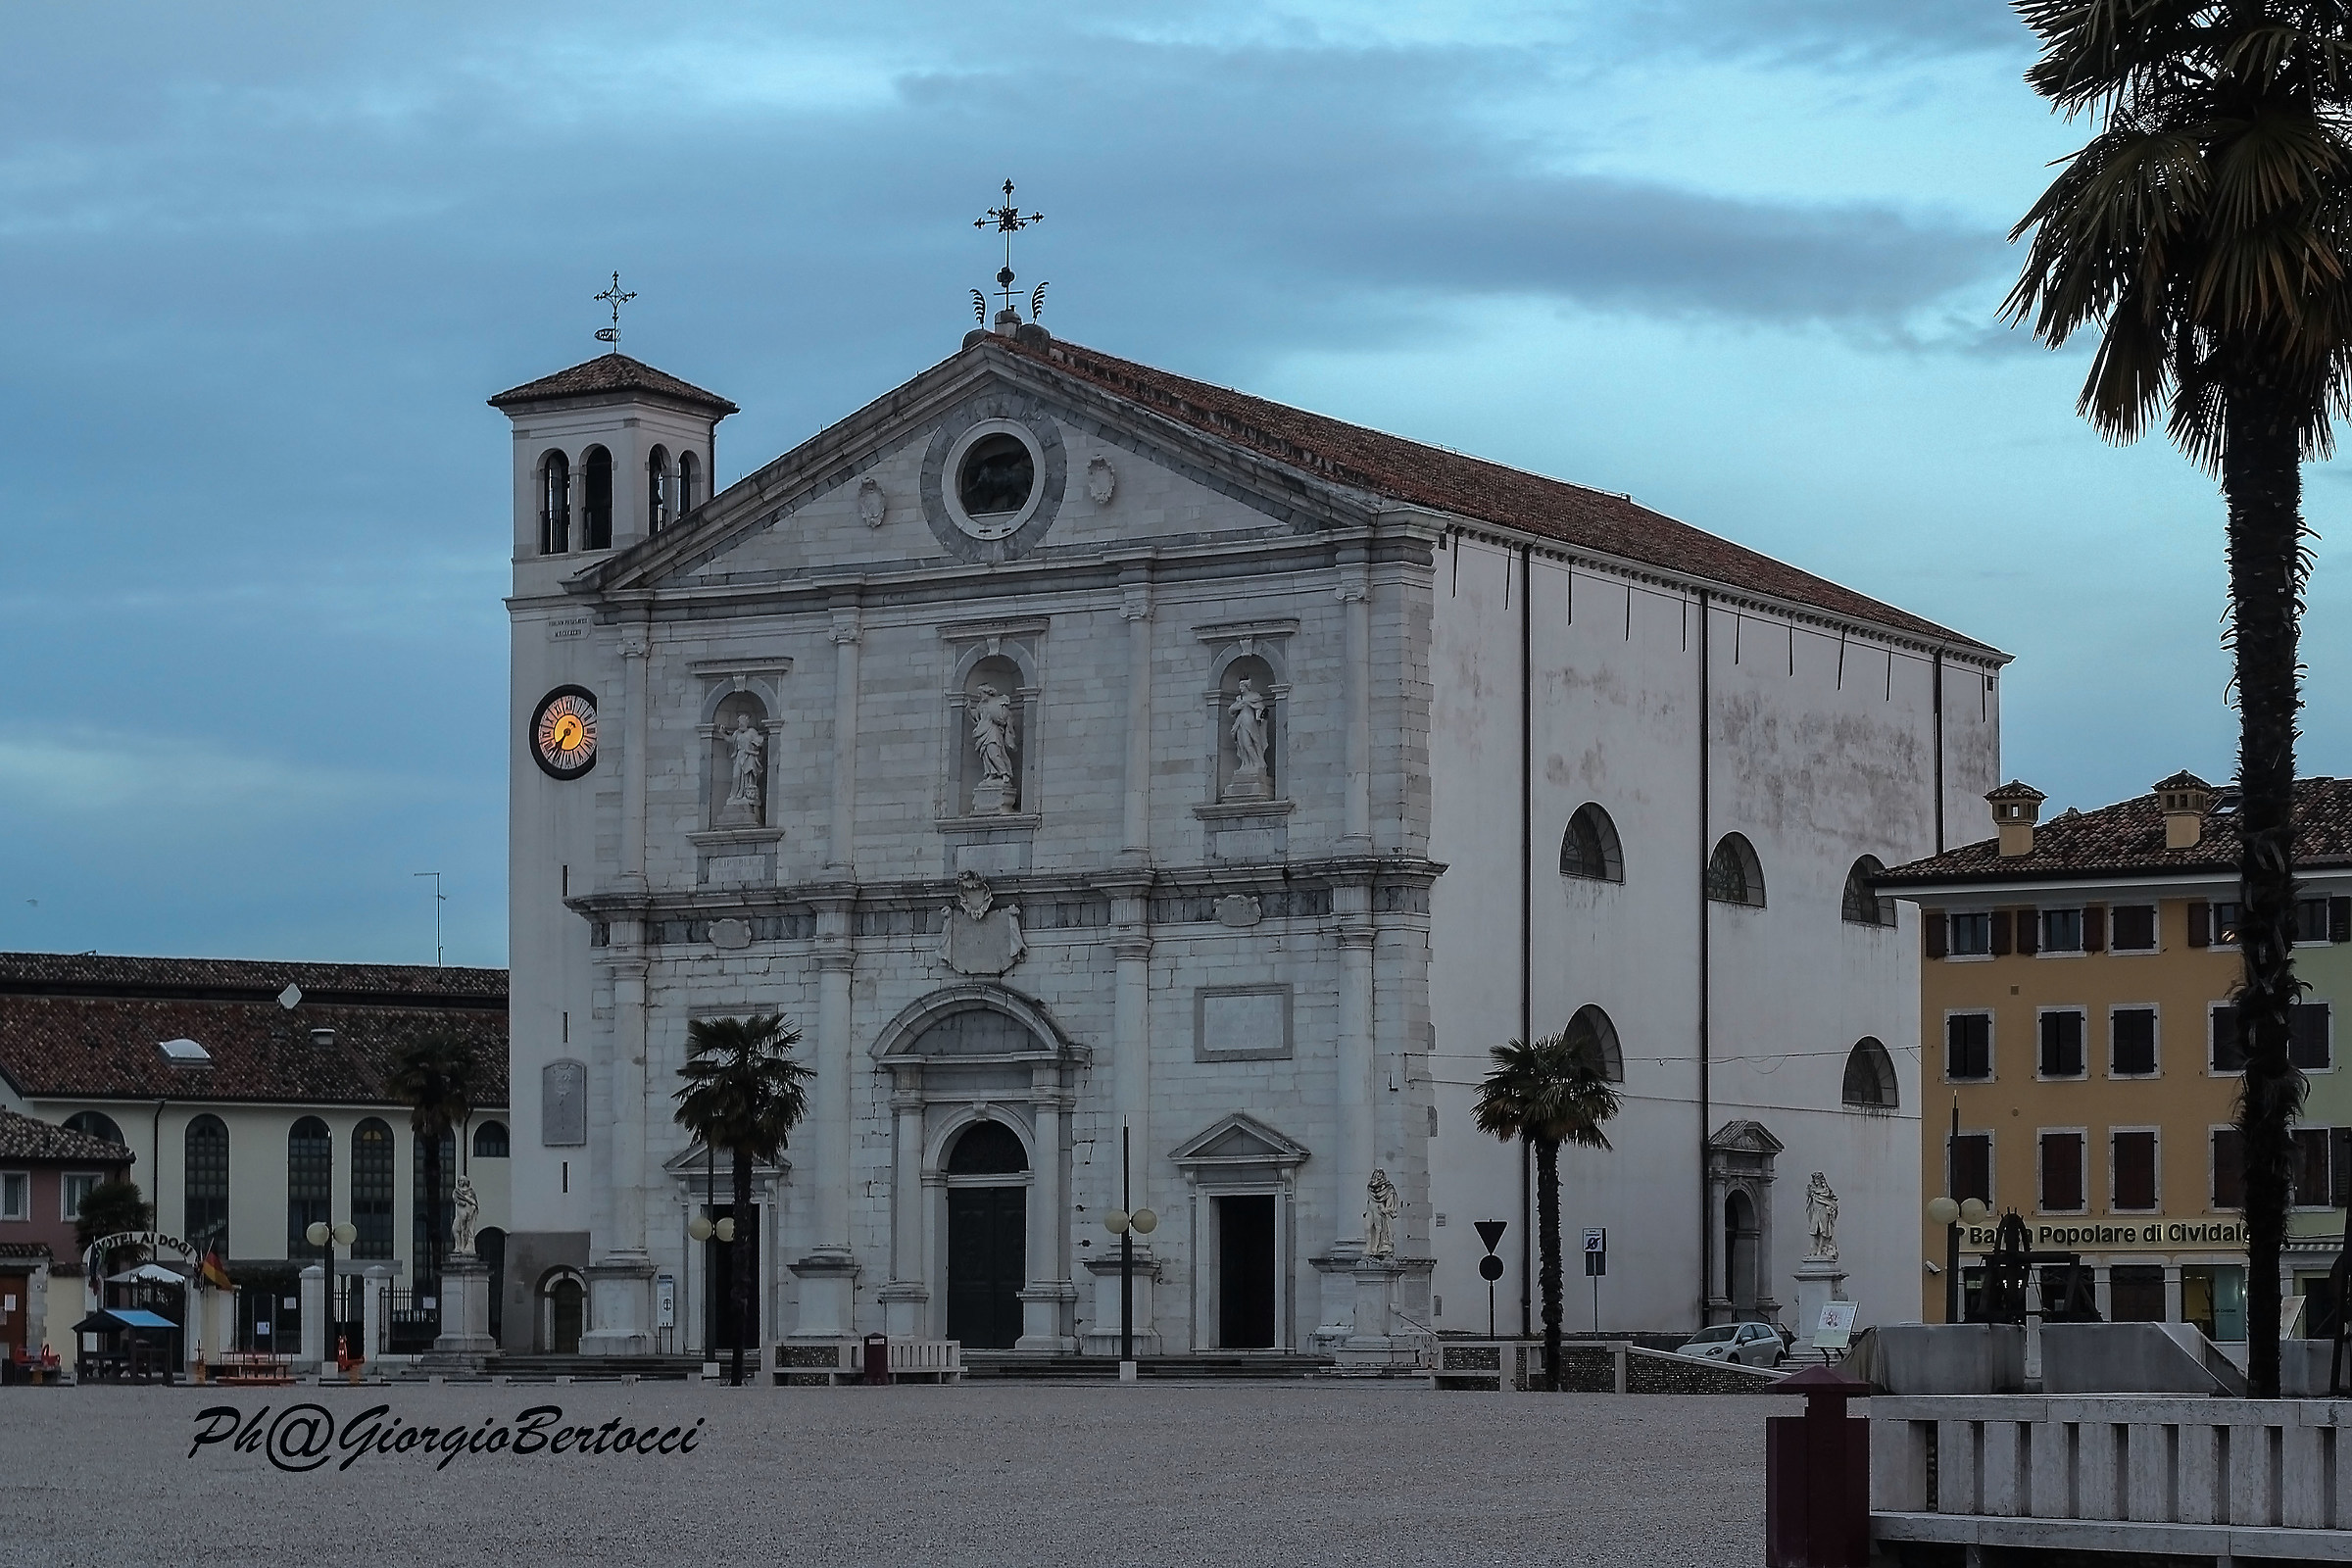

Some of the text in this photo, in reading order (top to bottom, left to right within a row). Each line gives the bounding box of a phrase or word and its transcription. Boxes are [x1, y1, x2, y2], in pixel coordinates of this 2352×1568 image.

[140, 1232, 155, 1244] AI
[158, 1233, 193, 1256] DOGI
[1970, 1227, 2033, 1244] Baa
[2039, 1224, 2136, 1246] Popolare
[2142, 1224, 2163, 1243] di
